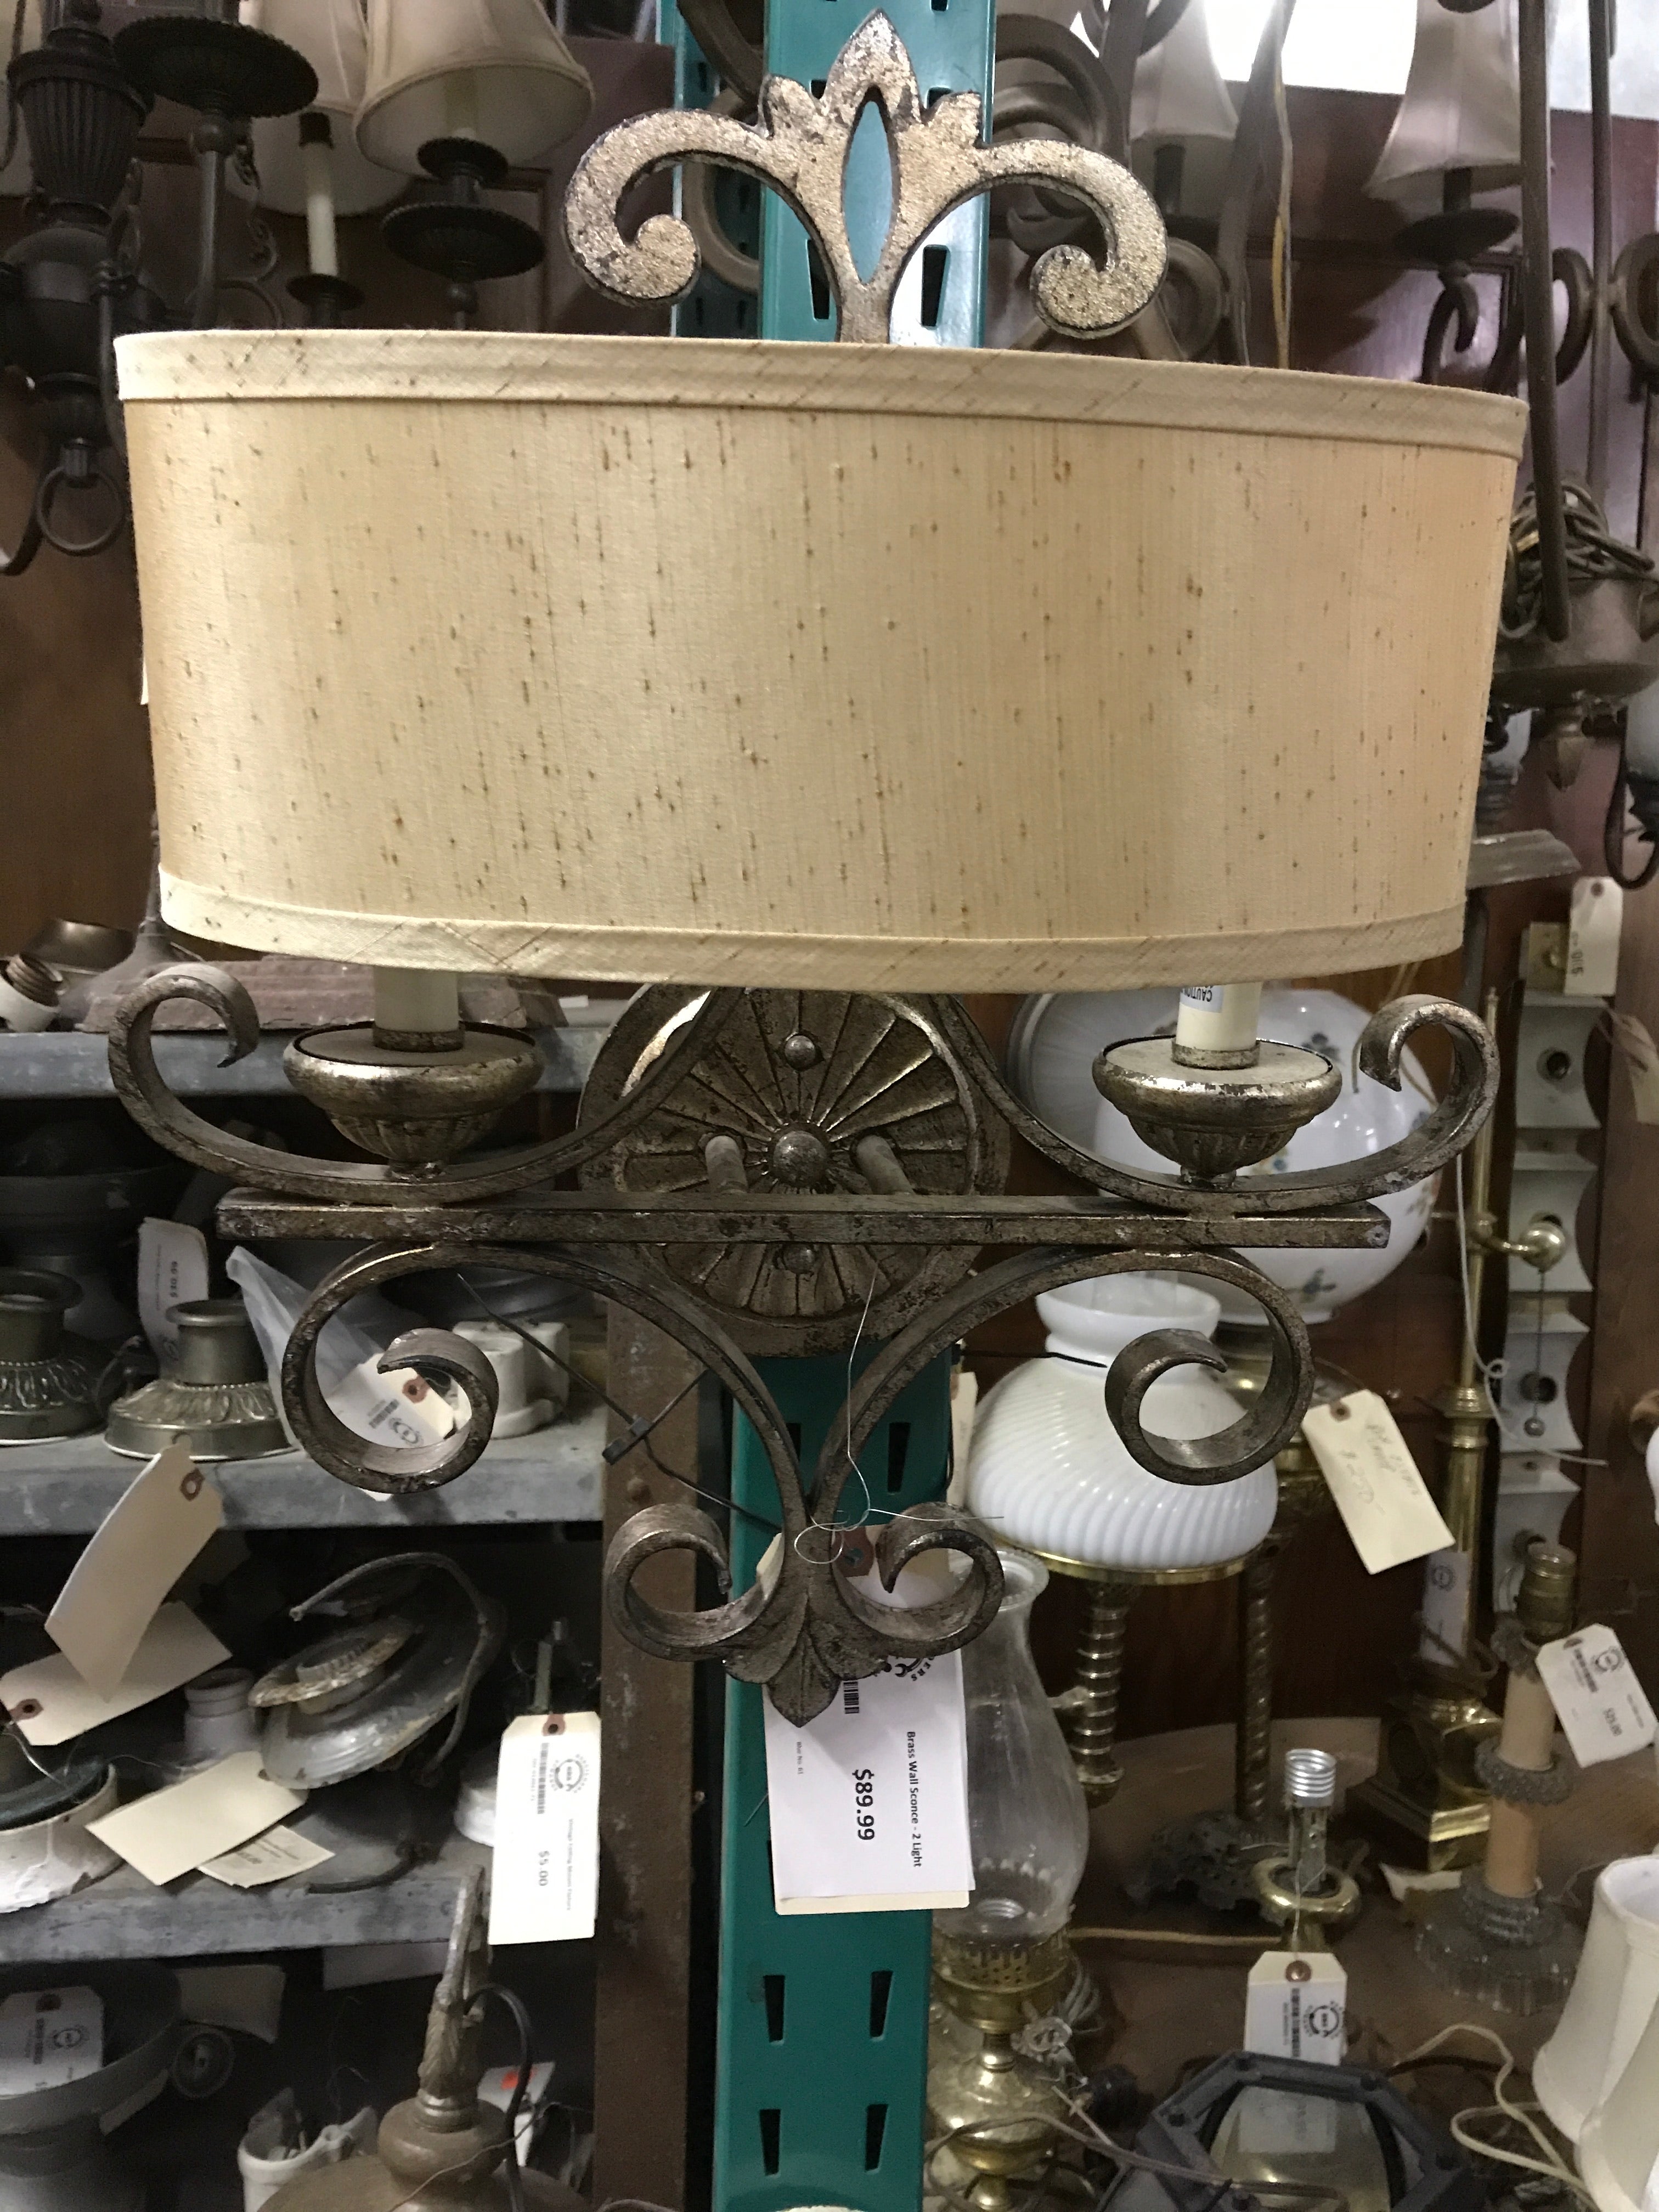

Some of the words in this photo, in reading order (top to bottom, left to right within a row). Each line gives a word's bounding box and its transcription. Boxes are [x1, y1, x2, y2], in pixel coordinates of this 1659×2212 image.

[907, 1731, 916, 1759] Brass
[909, 1760, 919, 1785] Wall
[851, 1769, 875, 1841] $89.99
[910, 1787, 919, 1824] Sconce
[911, 1842, 923, 1867] Light
